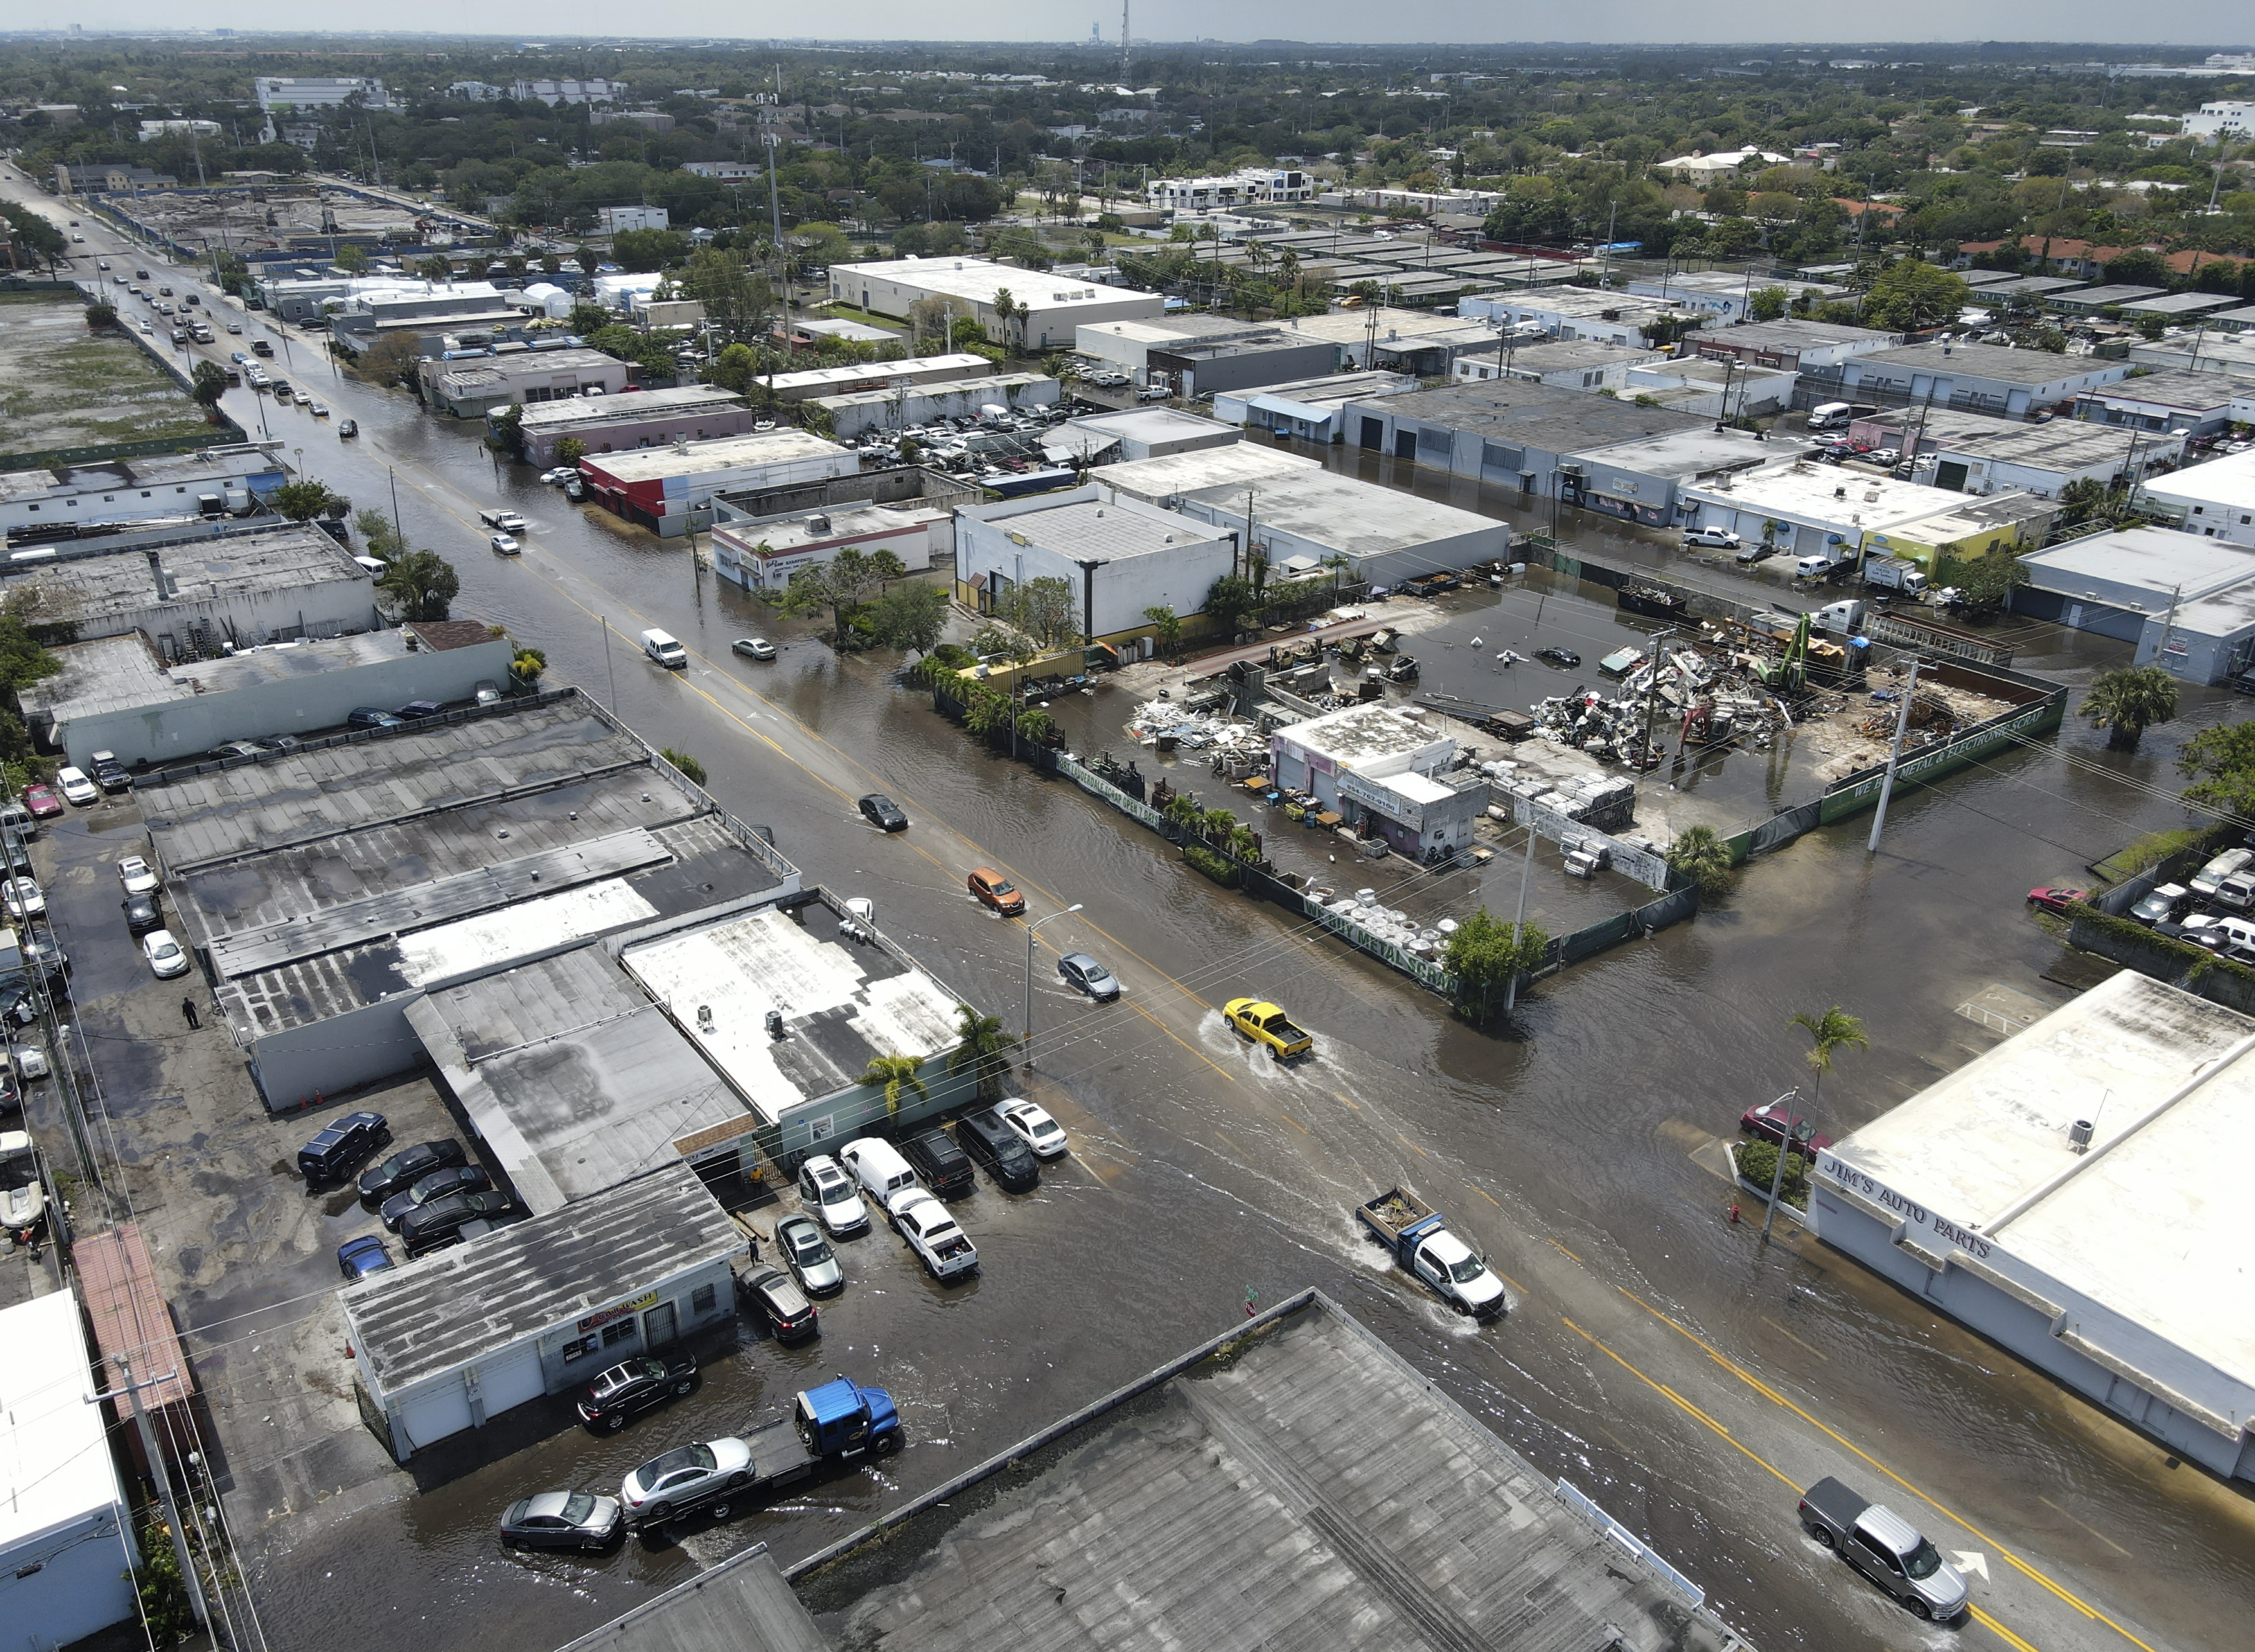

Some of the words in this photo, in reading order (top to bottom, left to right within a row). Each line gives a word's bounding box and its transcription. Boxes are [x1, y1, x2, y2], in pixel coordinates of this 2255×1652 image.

[1855, 782, 1872, 798] WE
[1900, 756, 1934, 779] METAL
[1936, 751, 1945, 764] &
[1946, 724, 2011, 759] ELECTRONIC
[2011, 710, 2043, 731] SCRAP
[1071, 764, 1104, 793] LAUDERDALE
[1105, 785, 1121, 803] SCRAP
[1123, 797, 1137, 815] OPEN
[1139, 806, 1142, 817] 7
[1144, 809, 1158, 826] DAYS
[1306, 901, 1325, 919] WE
[1328, 913, 1353, 938] BUY
[1358, 929, 1401, 966] METAL
[1407, 956, 1456, 993] SCRAP
[1825, 1160, 1874, 1194] JIM'S
[1878, 1189, 1927, 1224] AUTO
[1933, 1217, 1991, 1259] PARTS
[598, 1307, 619, 1321] CAR
[622, 1293, 652, 1310] WASH
[1244, 1302, 1256, 1314] STOP
